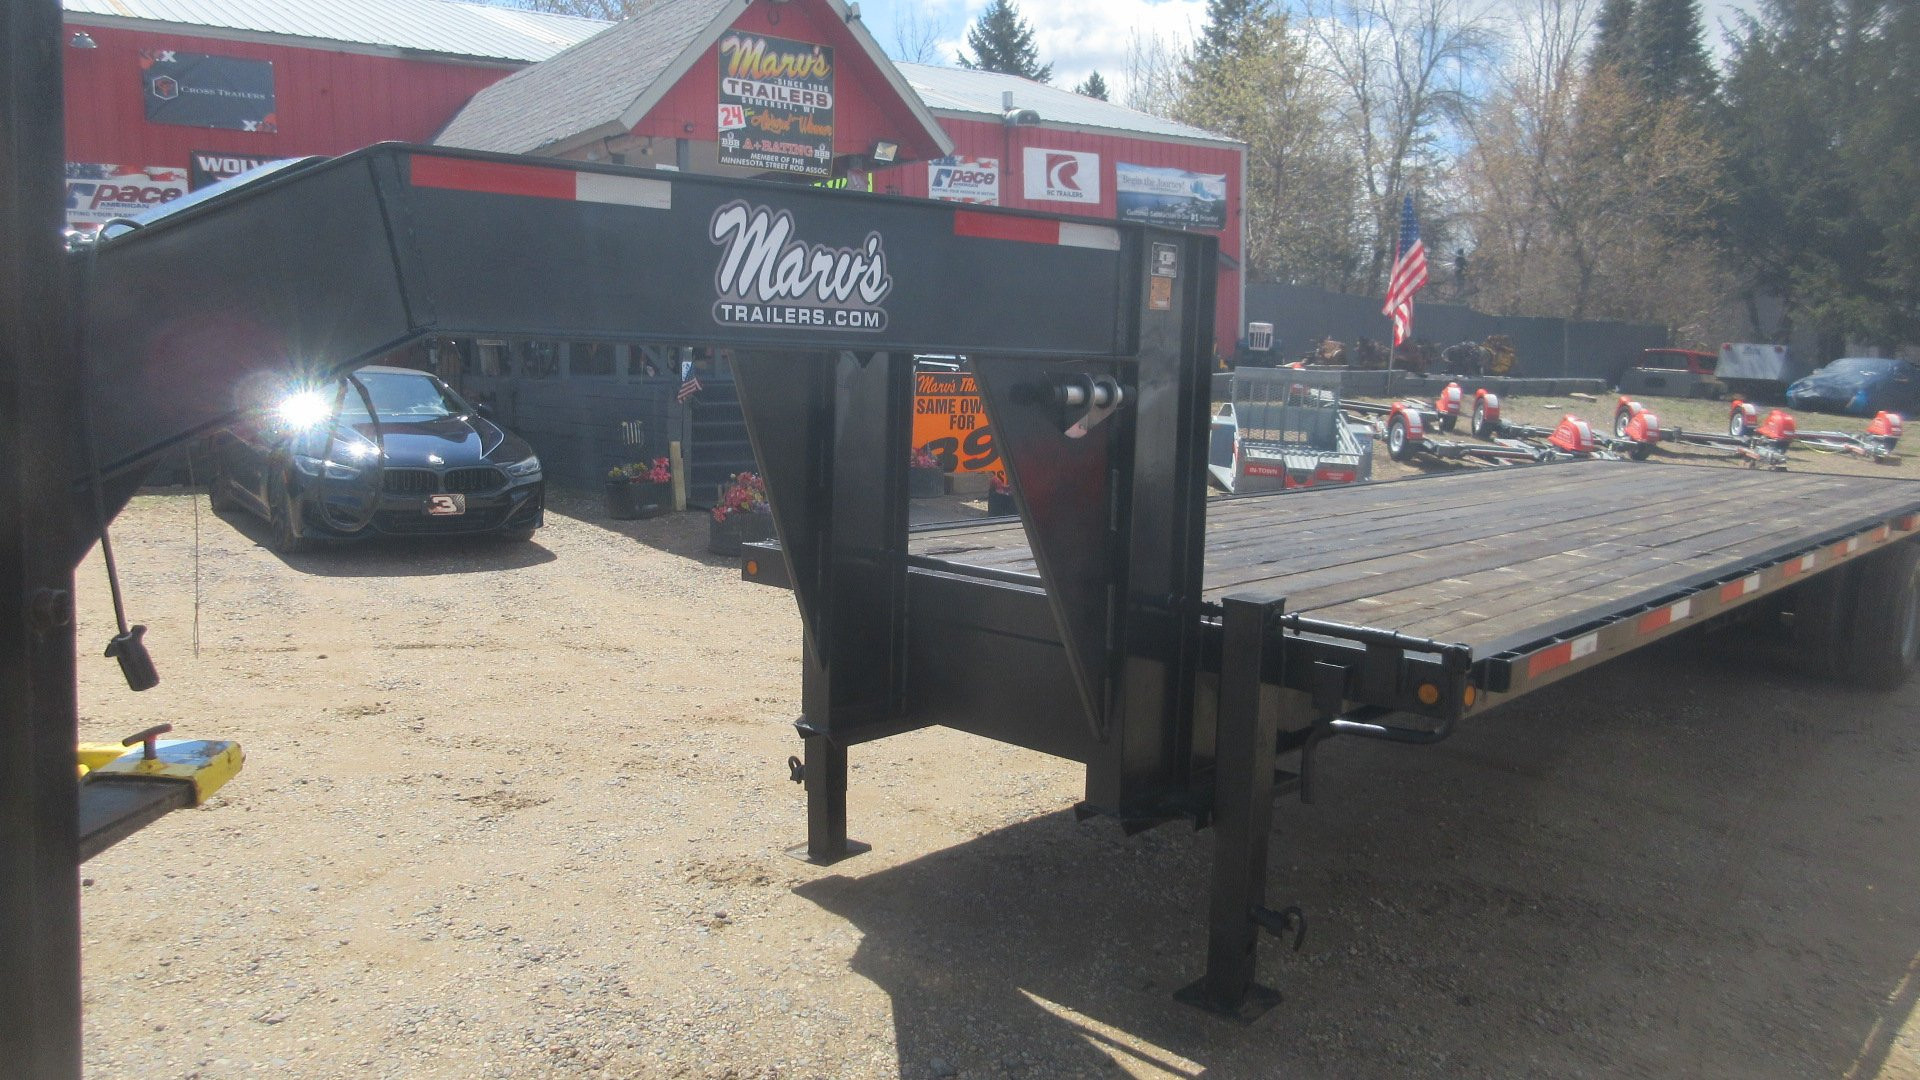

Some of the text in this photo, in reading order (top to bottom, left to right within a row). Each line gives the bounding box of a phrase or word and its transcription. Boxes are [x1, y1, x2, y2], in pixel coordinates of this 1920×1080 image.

[720, 36, 832, 79] Marv's
[218, 89, 266, 100] TRAILERS
[727, 80, 828, 108] TRAILERS
[720, 105, 744, 127] 24
[803, 105, 815, 114] WI
[720, 156, 829, 175] MINNESOTA STREET ROD ASSOC.
[751, 153, 779, 162] MEMBER
[780, 156, 791, 164] OF
[948, 169, 996, 188] pace
[89, 184, 183, 210] pace
[1056, 190, 1084, 199] TRAILERS
[715, 206, 888, 303] Marv's
[720, 304, 880, 328] TRAILERS.COM
[918, 376, 956, 393] Marv's
[917, 398, 985, 414] SAME OW
[949, 414, 975, 430] FOR
[1249, 467, 1278, 475] IN-TOWN
